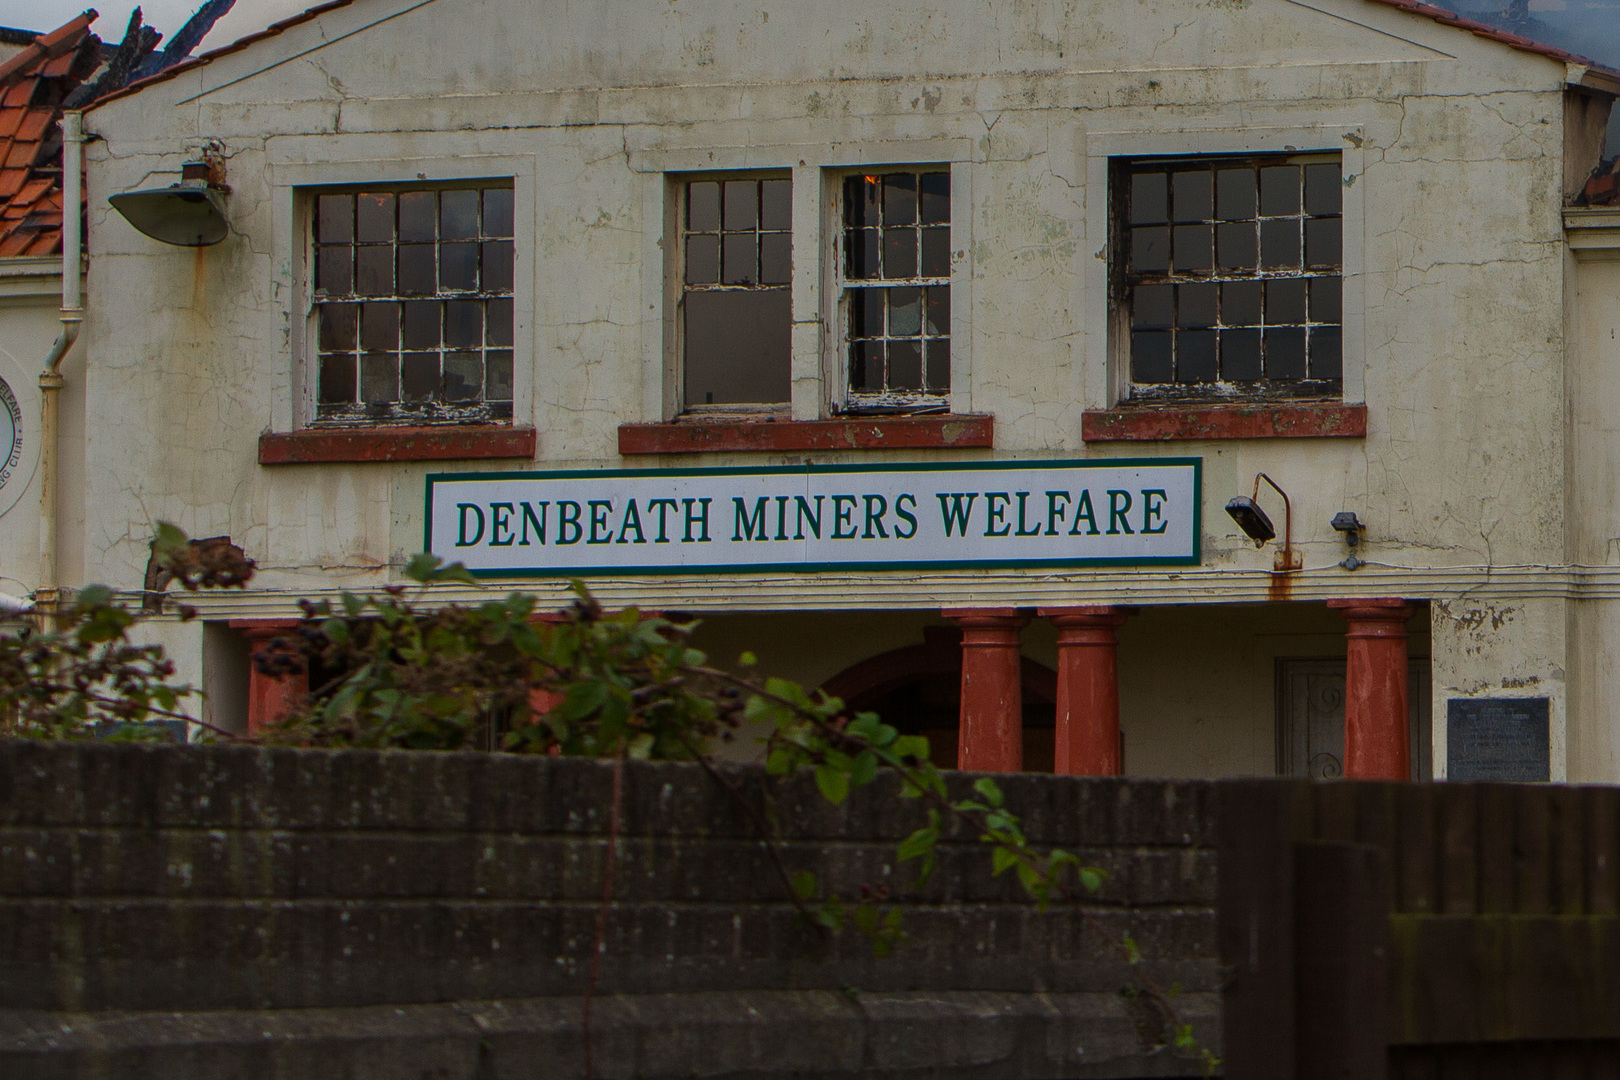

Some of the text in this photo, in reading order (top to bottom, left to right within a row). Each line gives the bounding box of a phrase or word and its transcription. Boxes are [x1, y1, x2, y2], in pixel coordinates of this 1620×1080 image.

[0, 382, 21, 423] ELFARE
[455, 488, 1169, 547] DENBEATH MINERS WELFARE
